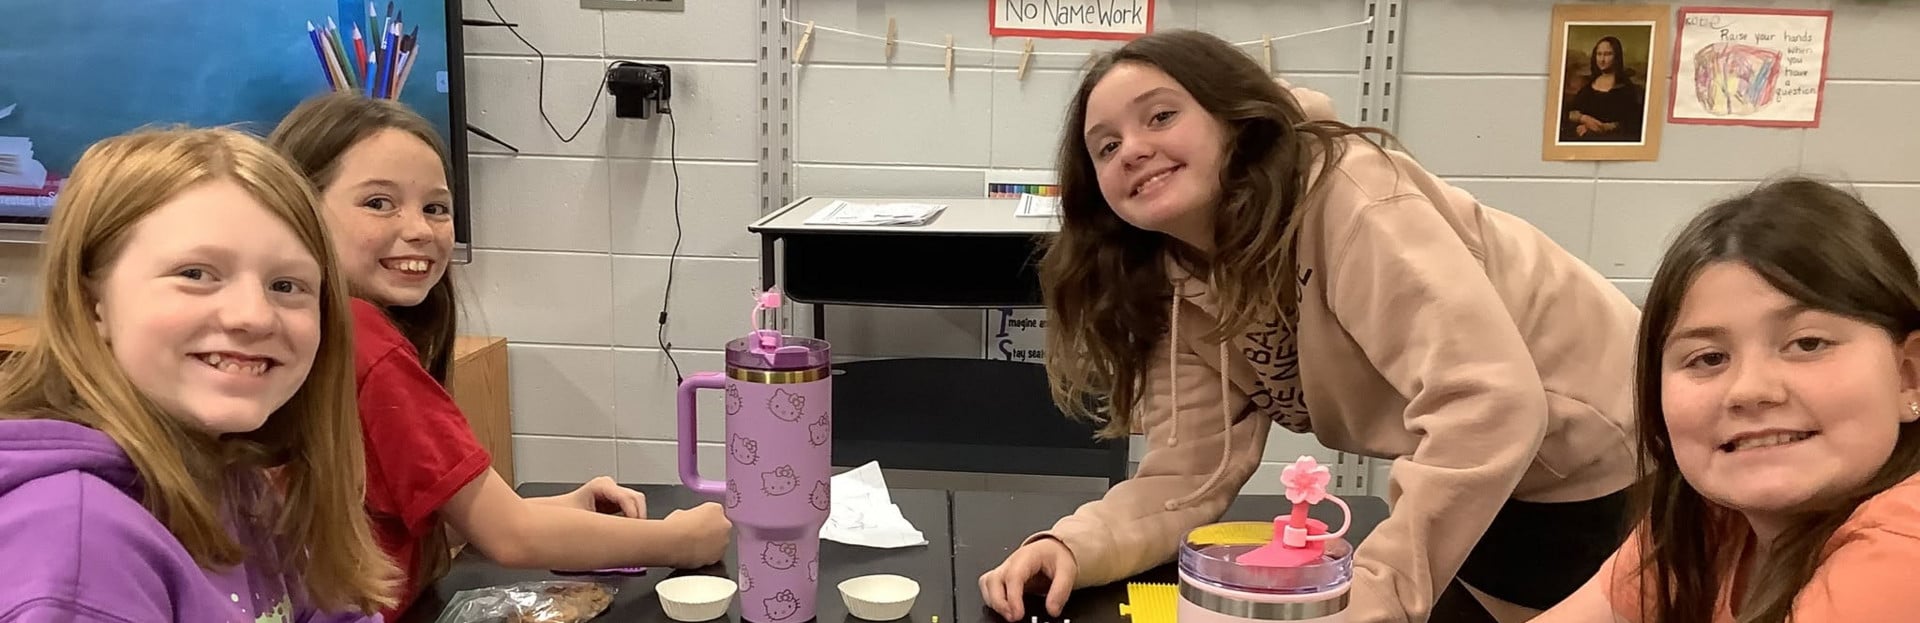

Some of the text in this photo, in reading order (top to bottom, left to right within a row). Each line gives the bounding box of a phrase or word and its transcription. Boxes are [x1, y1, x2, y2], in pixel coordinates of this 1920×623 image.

[1006, 0, 1037, 22] No
[1097, 0, 1142, 27] Work
[1720, 29, 1812, 44] Raise your hands
[1787, 57, 1803, 66] you
